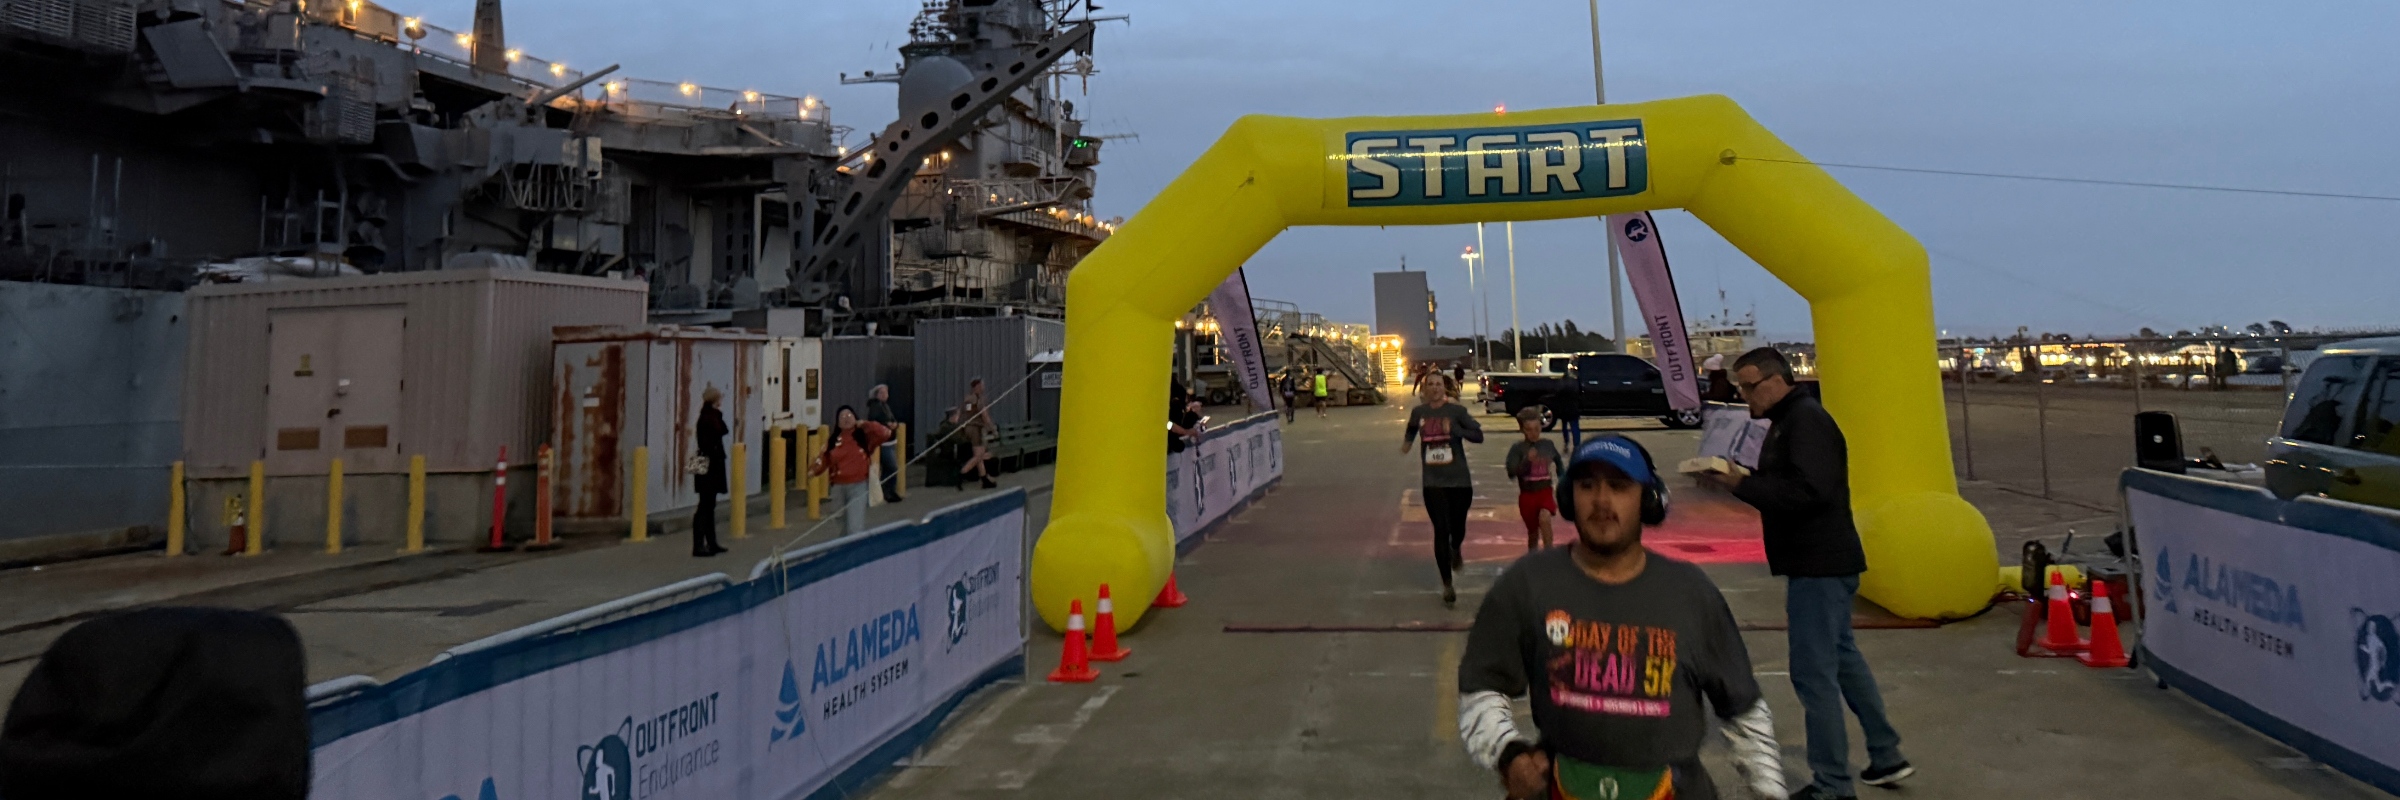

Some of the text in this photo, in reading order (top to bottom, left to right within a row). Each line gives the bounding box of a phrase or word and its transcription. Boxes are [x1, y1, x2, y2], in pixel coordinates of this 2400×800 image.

[1351, 127, 1638, 199] START
[1233, 327, 1259, 390] OUTFRONT
[1654, 315, 1684, 381] OUTFRONT
[2183, 553, 2306, 632] ALAMEDA
[810, 602, 920, 695] ALAMEDA
[1575, 619, 1612, 653] DAY
[1617, 624, 1640, 656] OF
[2193, 606, 2295, 659] HEALTH SYSTEM
[823, 658, 909, 720] HEALTH SYSTEM
[1574, 648, 1676, 698] DEAD 5K
[635, 691, 719, 758] OUTFRONT
[638, 739, 720, 800] Endurance
